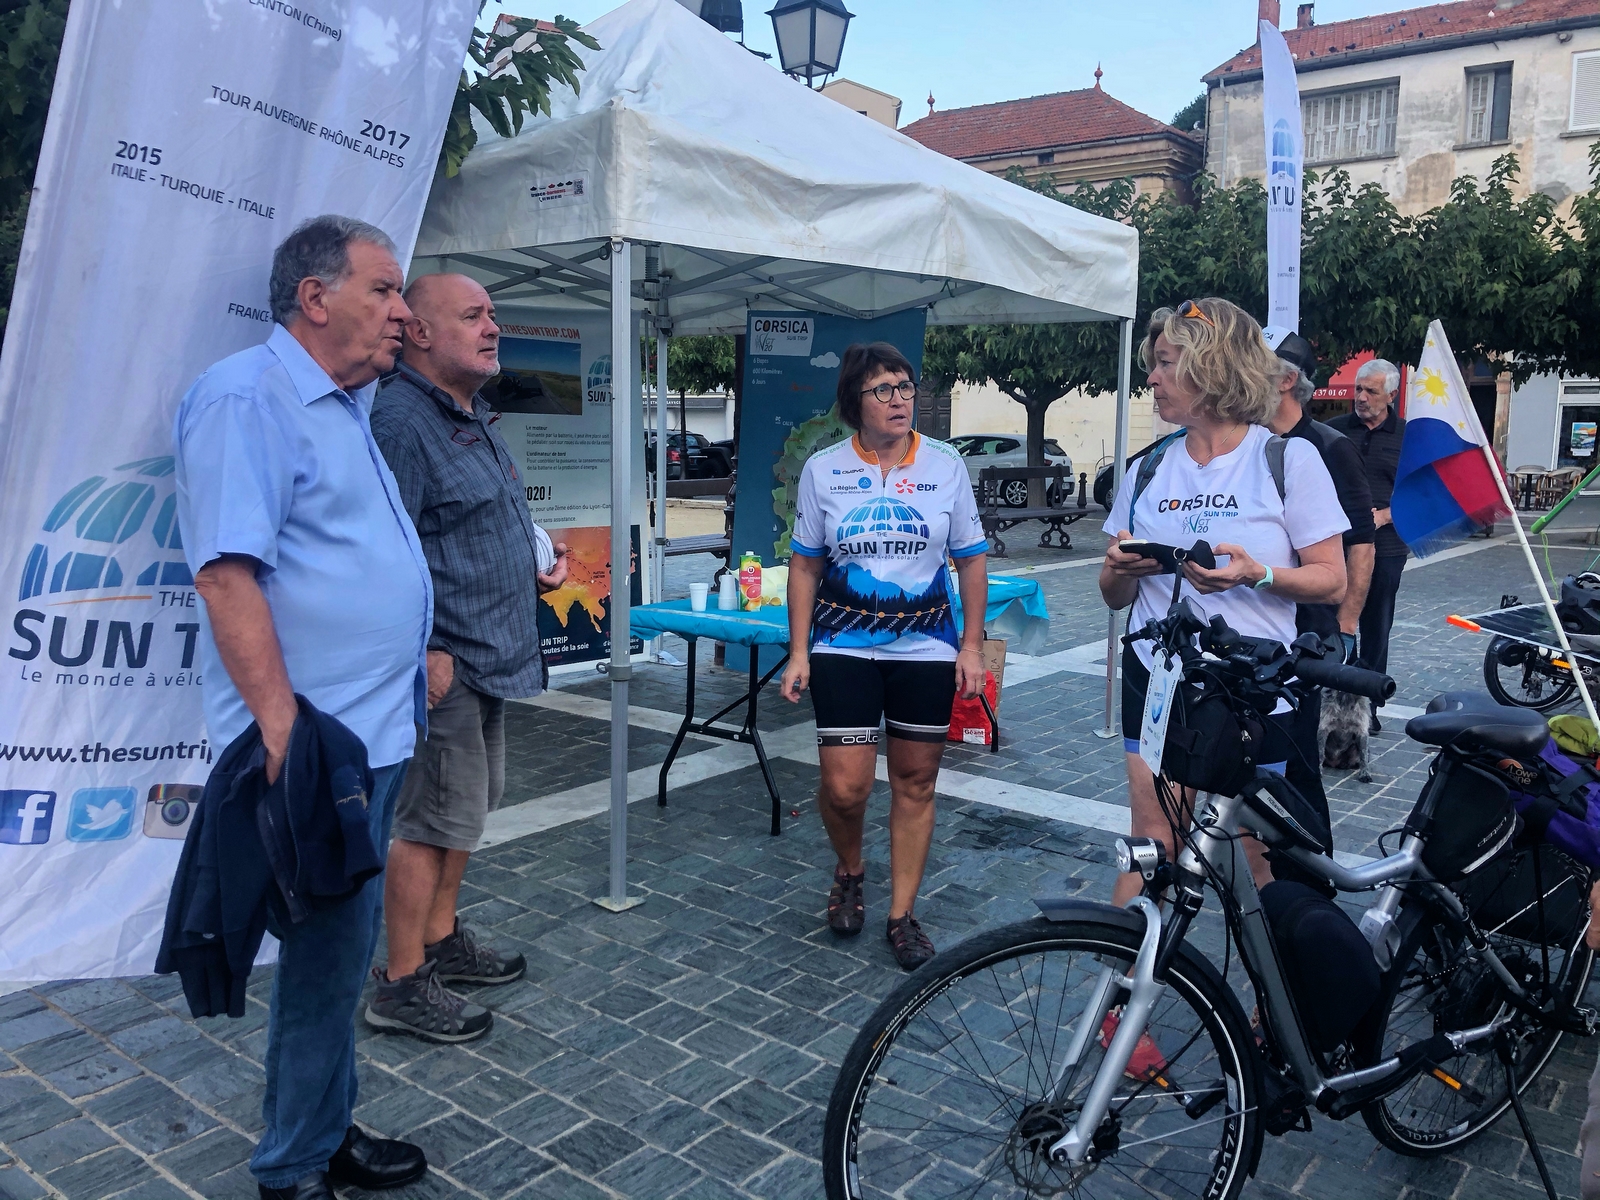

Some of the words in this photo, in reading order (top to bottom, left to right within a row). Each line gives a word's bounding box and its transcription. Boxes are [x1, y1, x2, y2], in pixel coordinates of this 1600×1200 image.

[303, 13, 342, 41] (Chine)
[211, 85, 251, 109] TOUR
[253, 100, 316, 135] AUVERGNE
[319, 126, 363, 153] RHÔNE
[363, 143, 406, 169] ALPES
[360, 119, 410, 150] 2017
[115, 140, 163, 166] 2015
[111, 162, 147, 183] ITALIE
[160, 174, 225, 204] TURQUIE
[237, 197, 276, 220] ITALIE
[754, 319, 809, 334] CORSICA
[588, 391, 606, 402] SUN
[525, 486, 545, 501] 020
[1158, 494, 1239, 513] CORSICA
[838, 541, 877, 555] SUN
[883, 541, 927, 555] TRIP
[158, 591, 196, 608] THE
[8, 608, 154, 669] SUN
[553, 636, 568, 645] TRIP
[577, 642, 590, 650] soie
[21, 665, 43, 683] Le
[56, 672, 135, 687] monde
[146, 672, 156, 687] à
[1510, 765, 1538, 779] Lowe
[885, 995, 918, 1031] CONTACT
[1407, 1130, 1437, 1141] TD17
